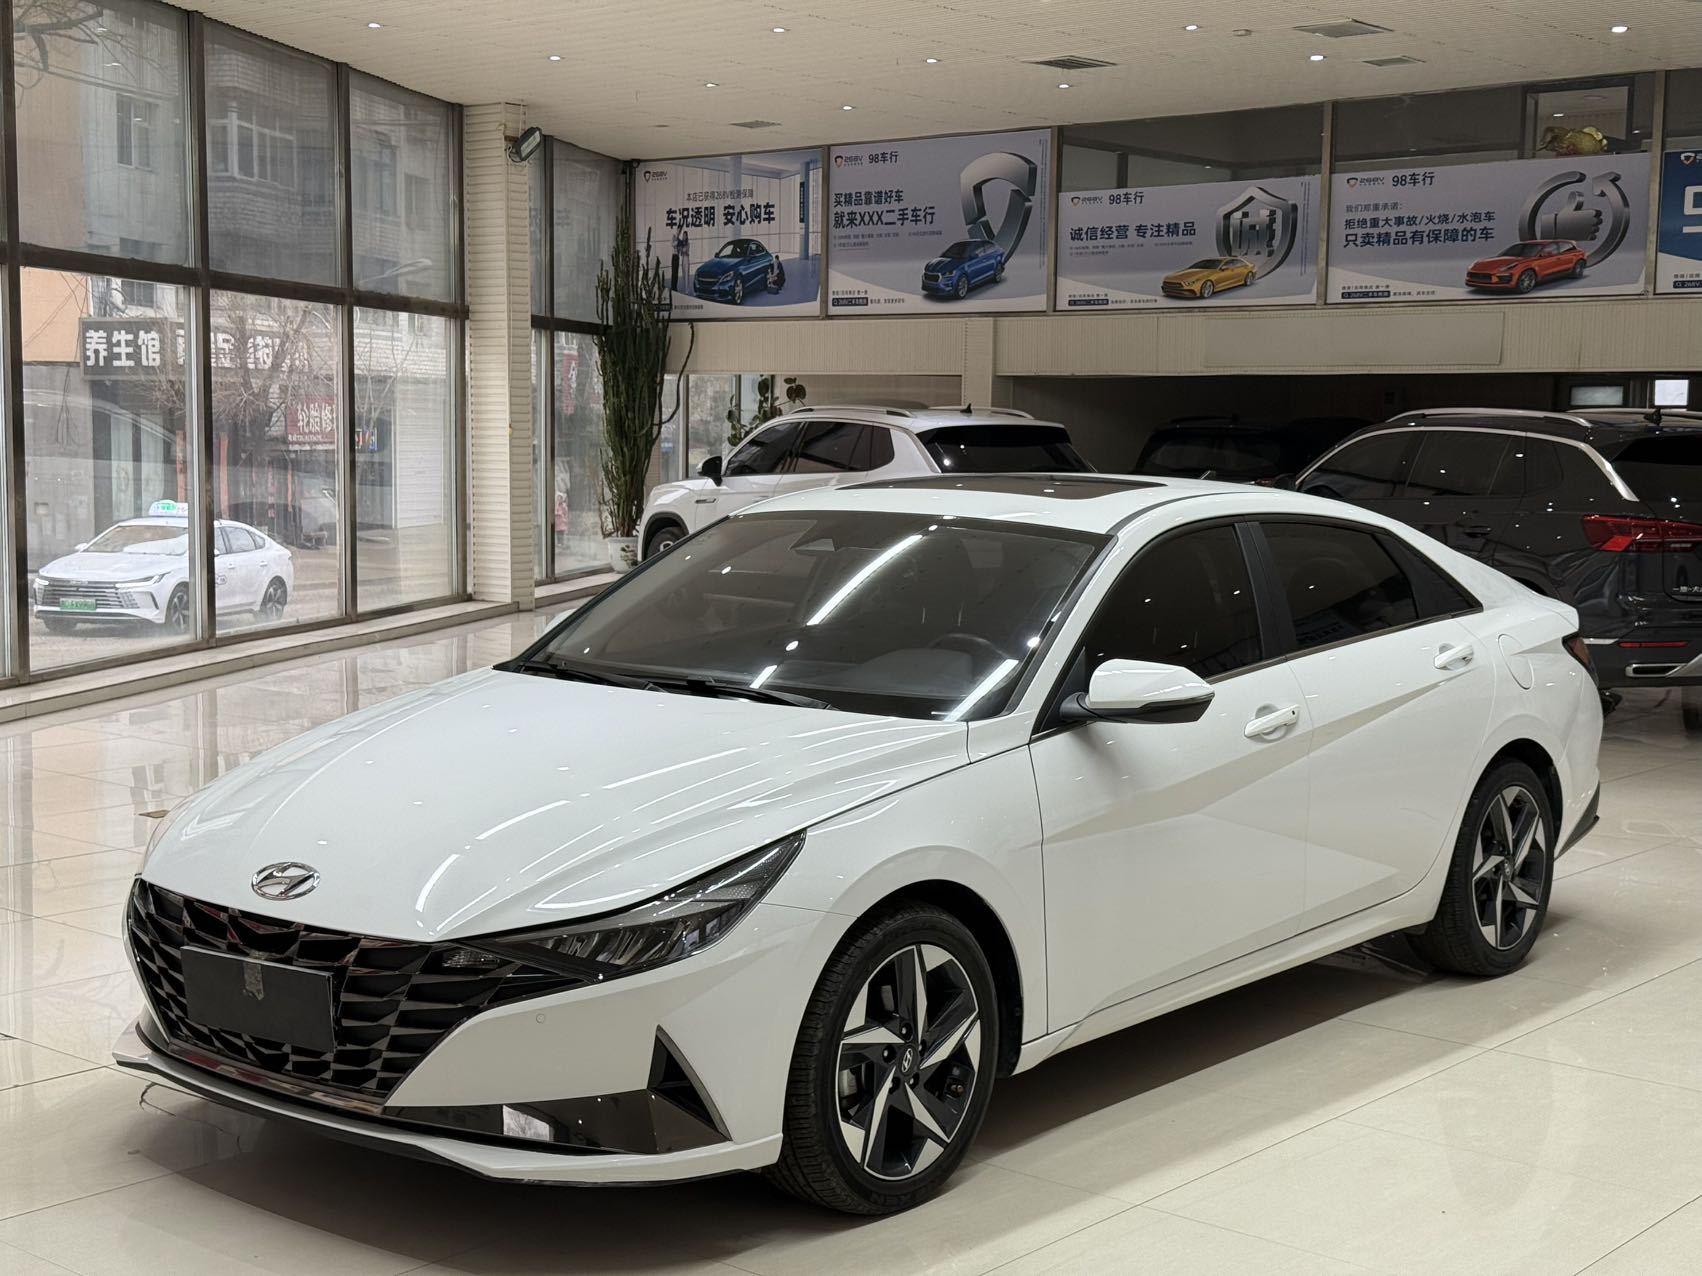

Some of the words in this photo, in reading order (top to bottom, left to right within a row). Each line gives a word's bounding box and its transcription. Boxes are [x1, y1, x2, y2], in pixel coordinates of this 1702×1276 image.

[868, 151, 899, 164] 98车行
[1391, 172, 1435, 187] 98车行
[833, 189, 904, 208] 买精品靠谱好车
[1108, 191, 1145, 205] 98车行
[665, 206, 716, 229] 车况透明
[722, 202, 776, 226] 安心购车
[832, 206, 936, 229] 就来XXX二手车行
[1344, 211, 1496, 230] 拒绝重大事故/火烧/水泡车
[1069, 224, 1130, 242] 诚信经营
[1134, 221, 1197, 239] 专注精品
[1343, 226, 1495, 248] 只卖精品有保障的车
[85, 330, 160, 367] 养生馆
